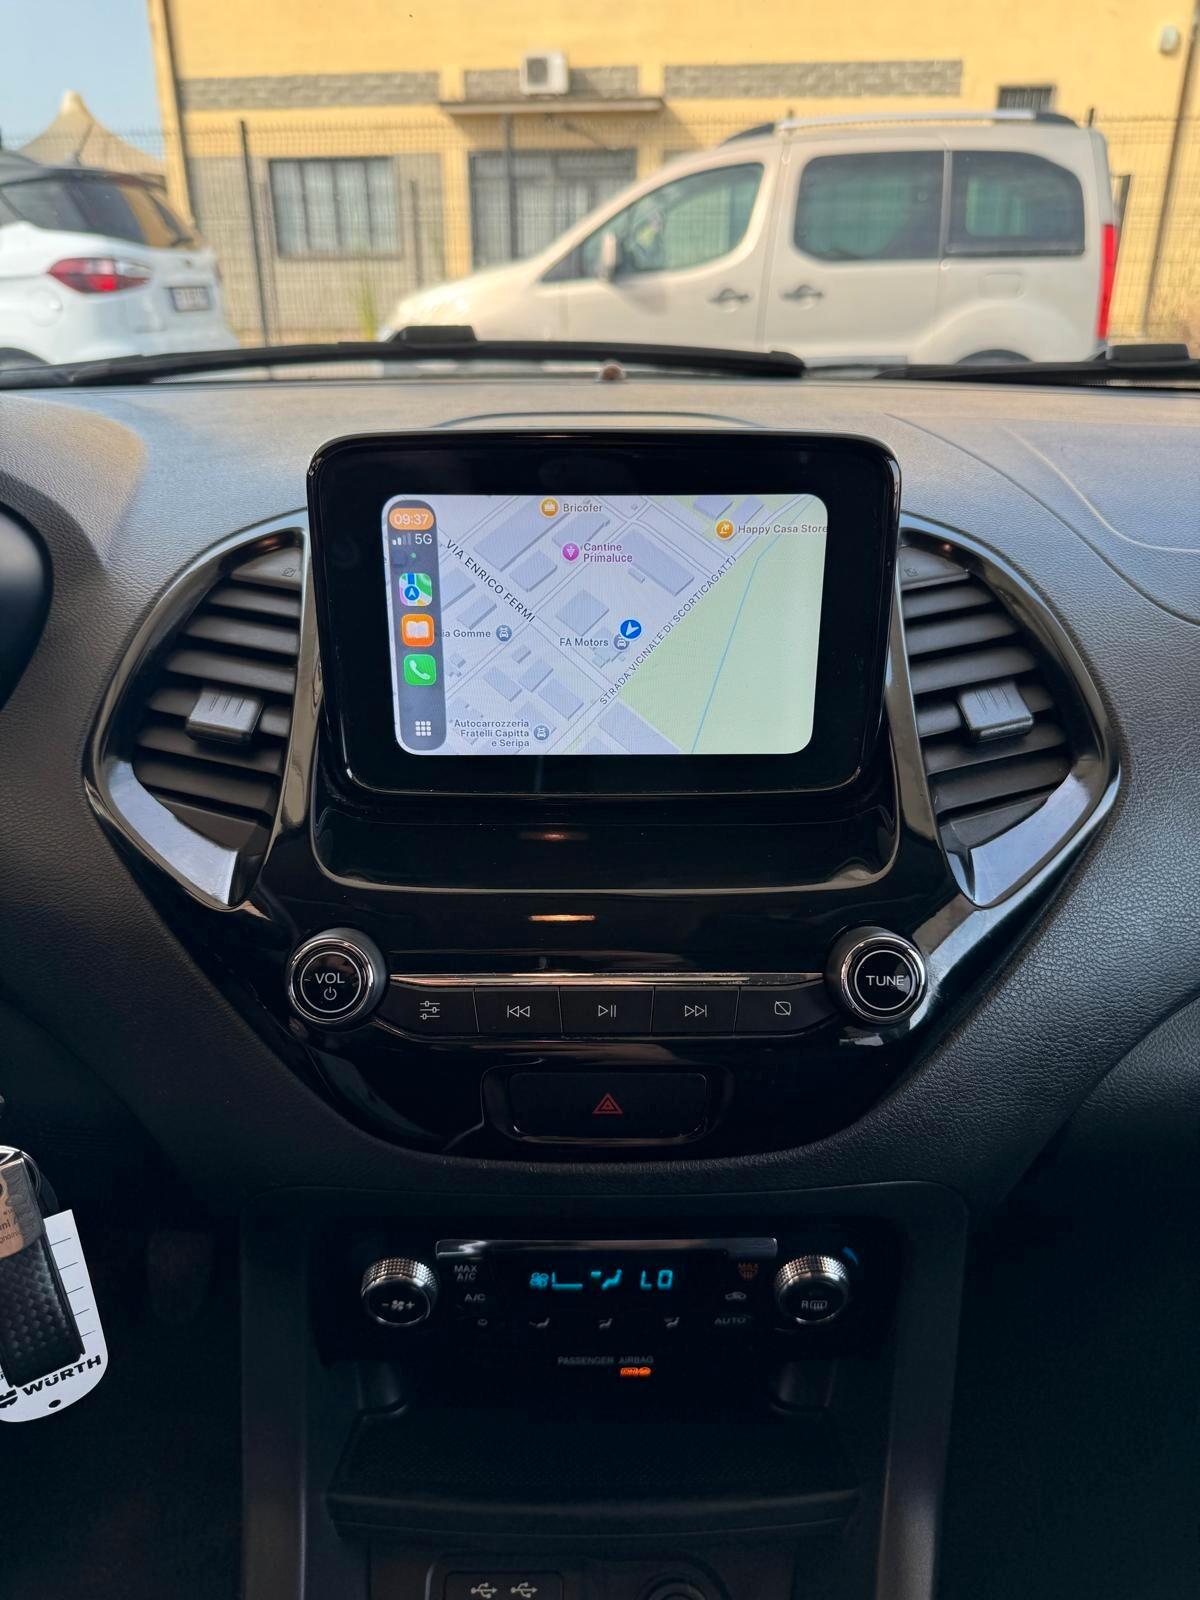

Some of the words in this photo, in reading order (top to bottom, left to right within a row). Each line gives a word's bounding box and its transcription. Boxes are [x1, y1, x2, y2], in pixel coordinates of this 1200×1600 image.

[563, 503, 603, 512] Bricofer
[394, 514, 429, 525] 09:37
[738, 525, 770, 535] Happy
[773, 525, 798, 533] Casa
[801, 524, 828, 533] Store
[415, 534, 433, 545] 5G
[583, 543, 622, 551] Cantine
[583, 553, 633, 562] Primaluce
[447, 540, 463, 559] VIA
[464, 557, 505, 594] ENRICO
[503, 592, 536, 623] FERMI
[453, 629, 491, 638] Gomme
[600, 672, 631, 705] STRADA
[630, 632, 665, 672] VICINALE
[663, 622, 675, 633] DI
[672, 555, 737, 623] SCORTICAGATTI
[559, 637, 572, 646] FA
[575, 637, 609, 646] Motors
[454, 719, 530, 728] Autocarrozzeria
[460, 729, 493, 737] Fratelli
[495, 729, 530, 739] Capitta
[499, 739, 530, 748] Seripa
[314, 972, 346, 985] VOL
[866, 975, 905, 986] TUNE
[454, 1264, 478, 1273] MAX
[640, 1269, 674, 1289] LO
[714, 1317, 747, 1326] AUTO
[22, 1355, 101, 1396] WÜRTH
